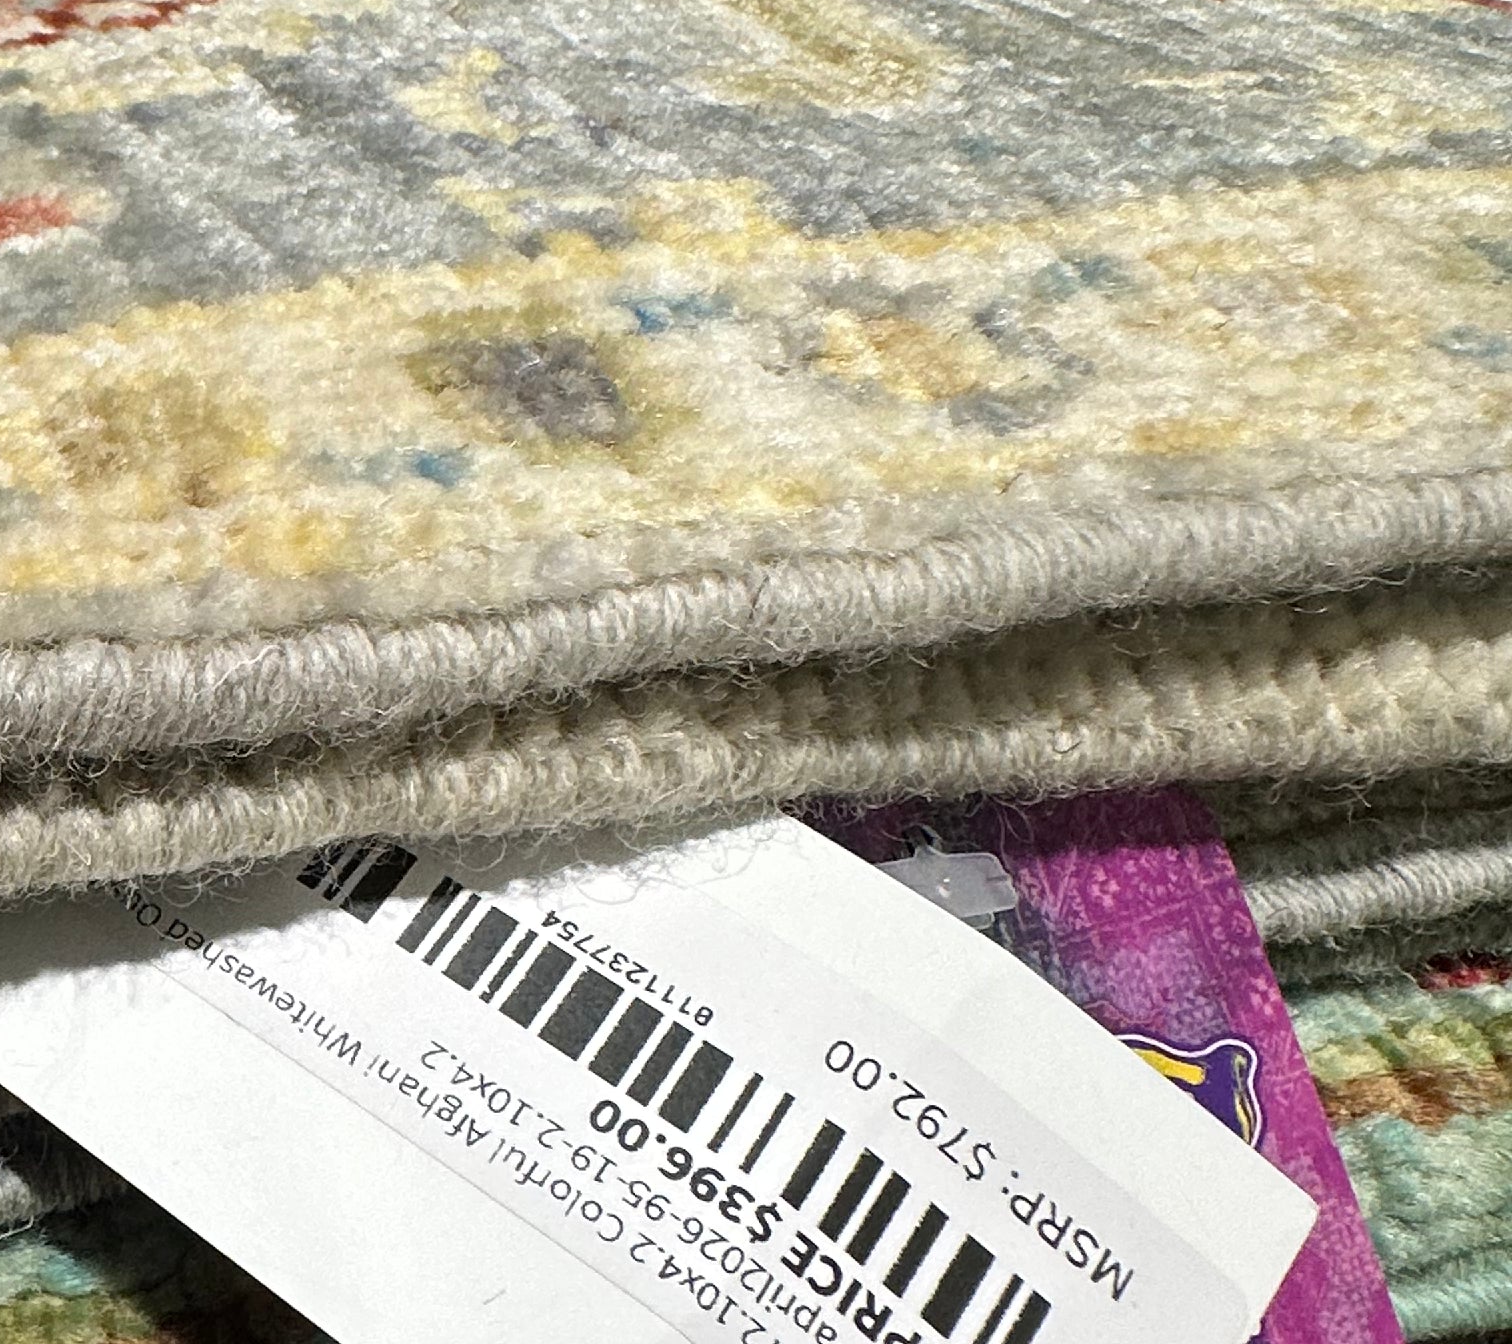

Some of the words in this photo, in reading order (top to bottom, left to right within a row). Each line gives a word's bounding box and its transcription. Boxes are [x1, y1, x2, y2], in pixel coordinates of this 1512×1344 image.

[161, 917, 362, 1067] Whitewashed
[541, 910, 714, 1027] 0111237754
[364, 1054, 489, 1147] Afghani
[824, 1040, 997, 1181] $792.00
[489, 1138, 624, 1242] Colorful
[589, 1099, 784, 1242] $396.00
[1001, 1170, 1135, 1302] MSRP:
